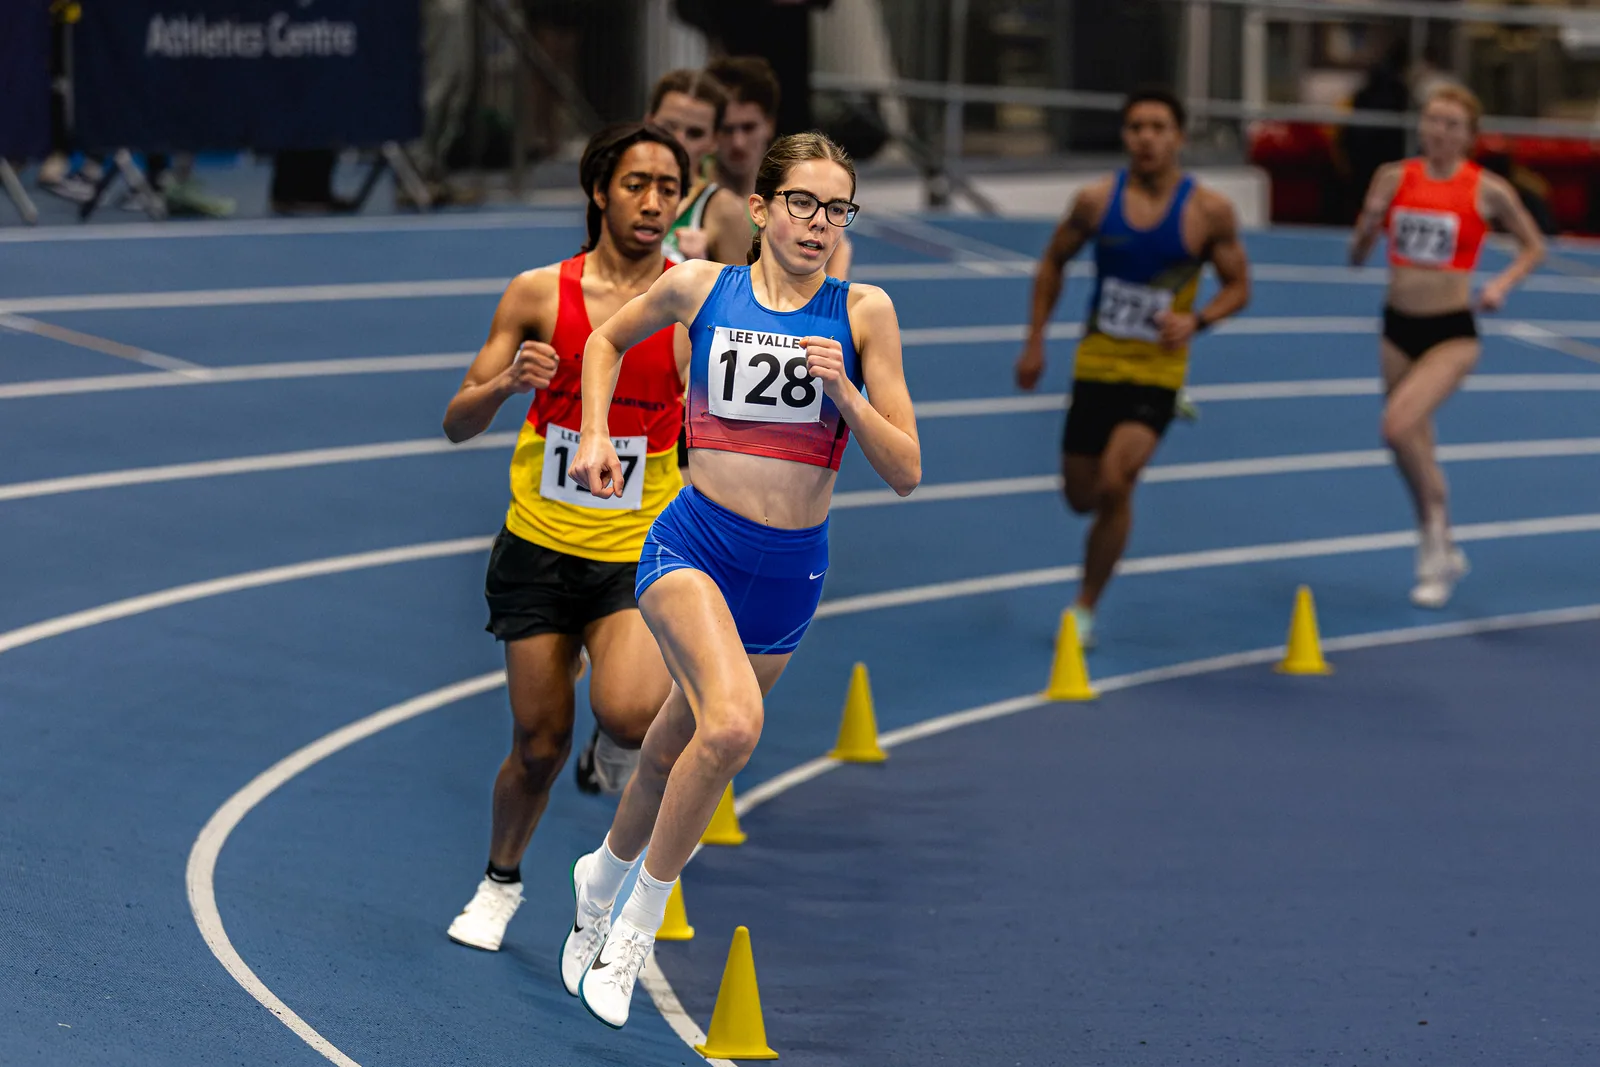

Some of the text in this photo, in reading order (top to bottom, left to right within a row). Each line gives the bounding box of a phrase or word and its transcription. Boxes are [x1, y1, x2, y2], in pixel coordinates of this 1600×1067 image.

[146, 12, 357, 58] Athletics Centre
[729, 330, 800, 349] LEE VALLE
[719, 349, 816, 408] 128
[554, 446, 638, 496] 17
